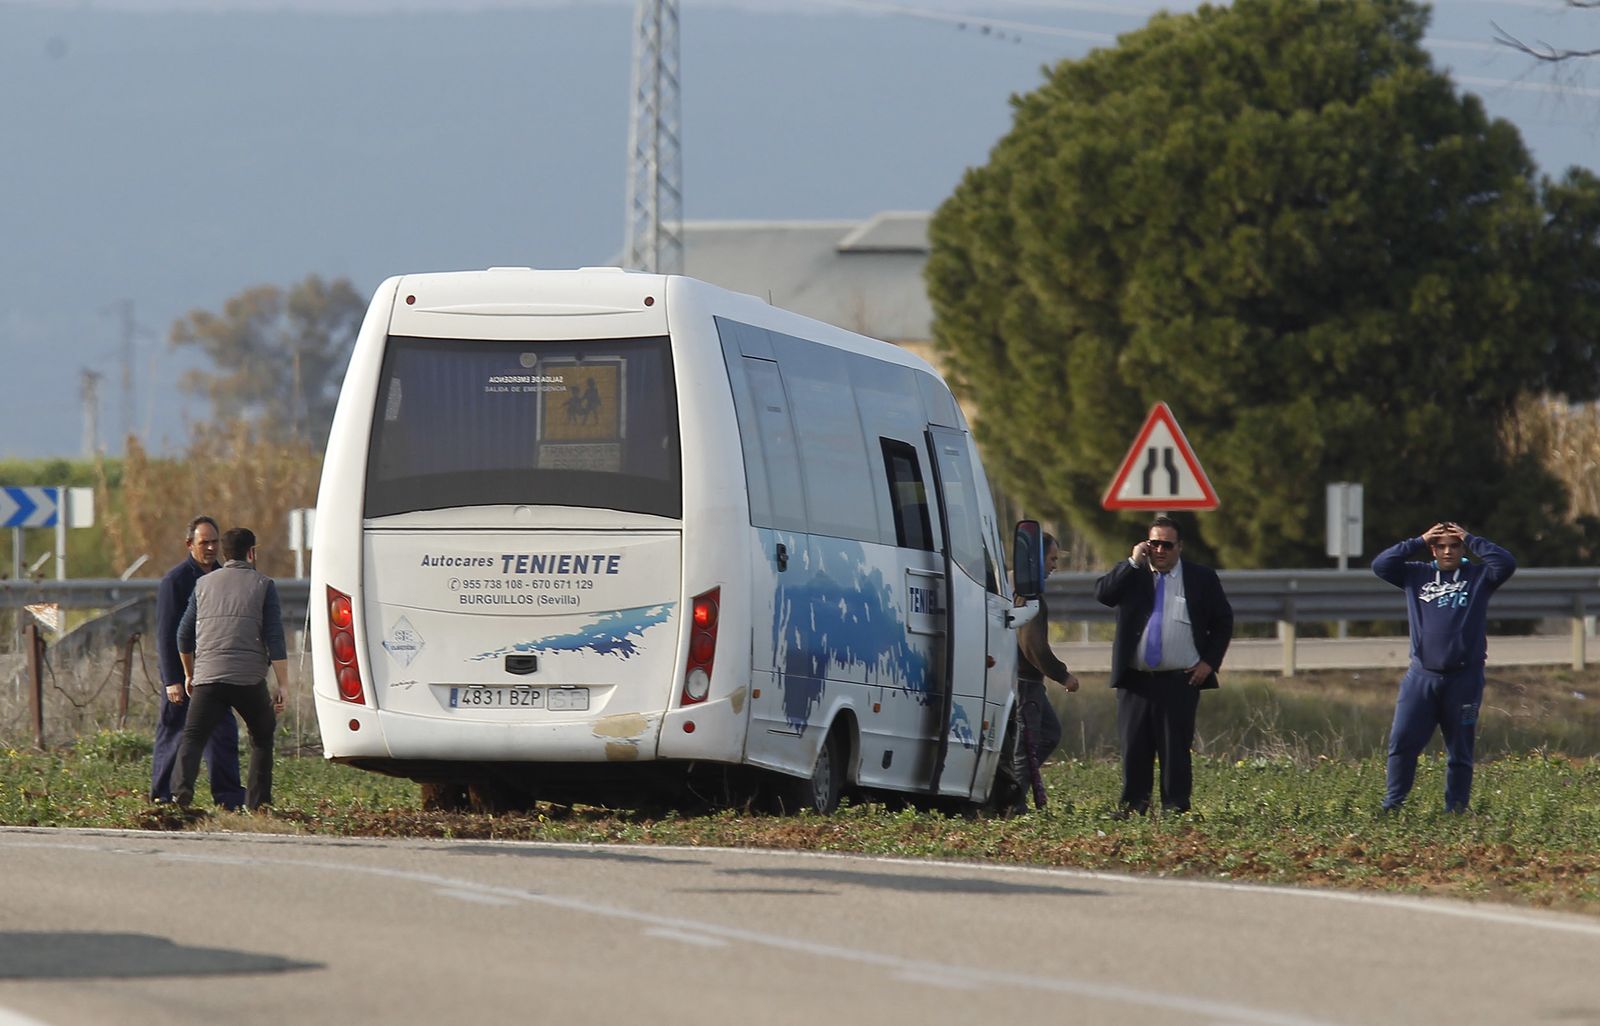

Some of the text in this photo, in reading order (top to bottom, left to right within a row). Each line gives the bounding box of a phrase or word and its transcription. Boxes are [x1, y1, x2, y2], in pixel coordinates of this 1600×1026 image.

[421, 554, 622, 575] Autocares TENIENTE
[463, 579, 481, 589] 955
[484, 579, 502, 589] 738
[505, 579, 523, 589] 108
[532, 579, 551, 589] 670
[553, 579, 571, 589] 671
[575, 579, 593, 590] 129
[459, 594, 581, 606] BURGUILLOS (Sevilla)
[461, 690, 502, 706] 4831
[509, 690, 541, 706] BZP
